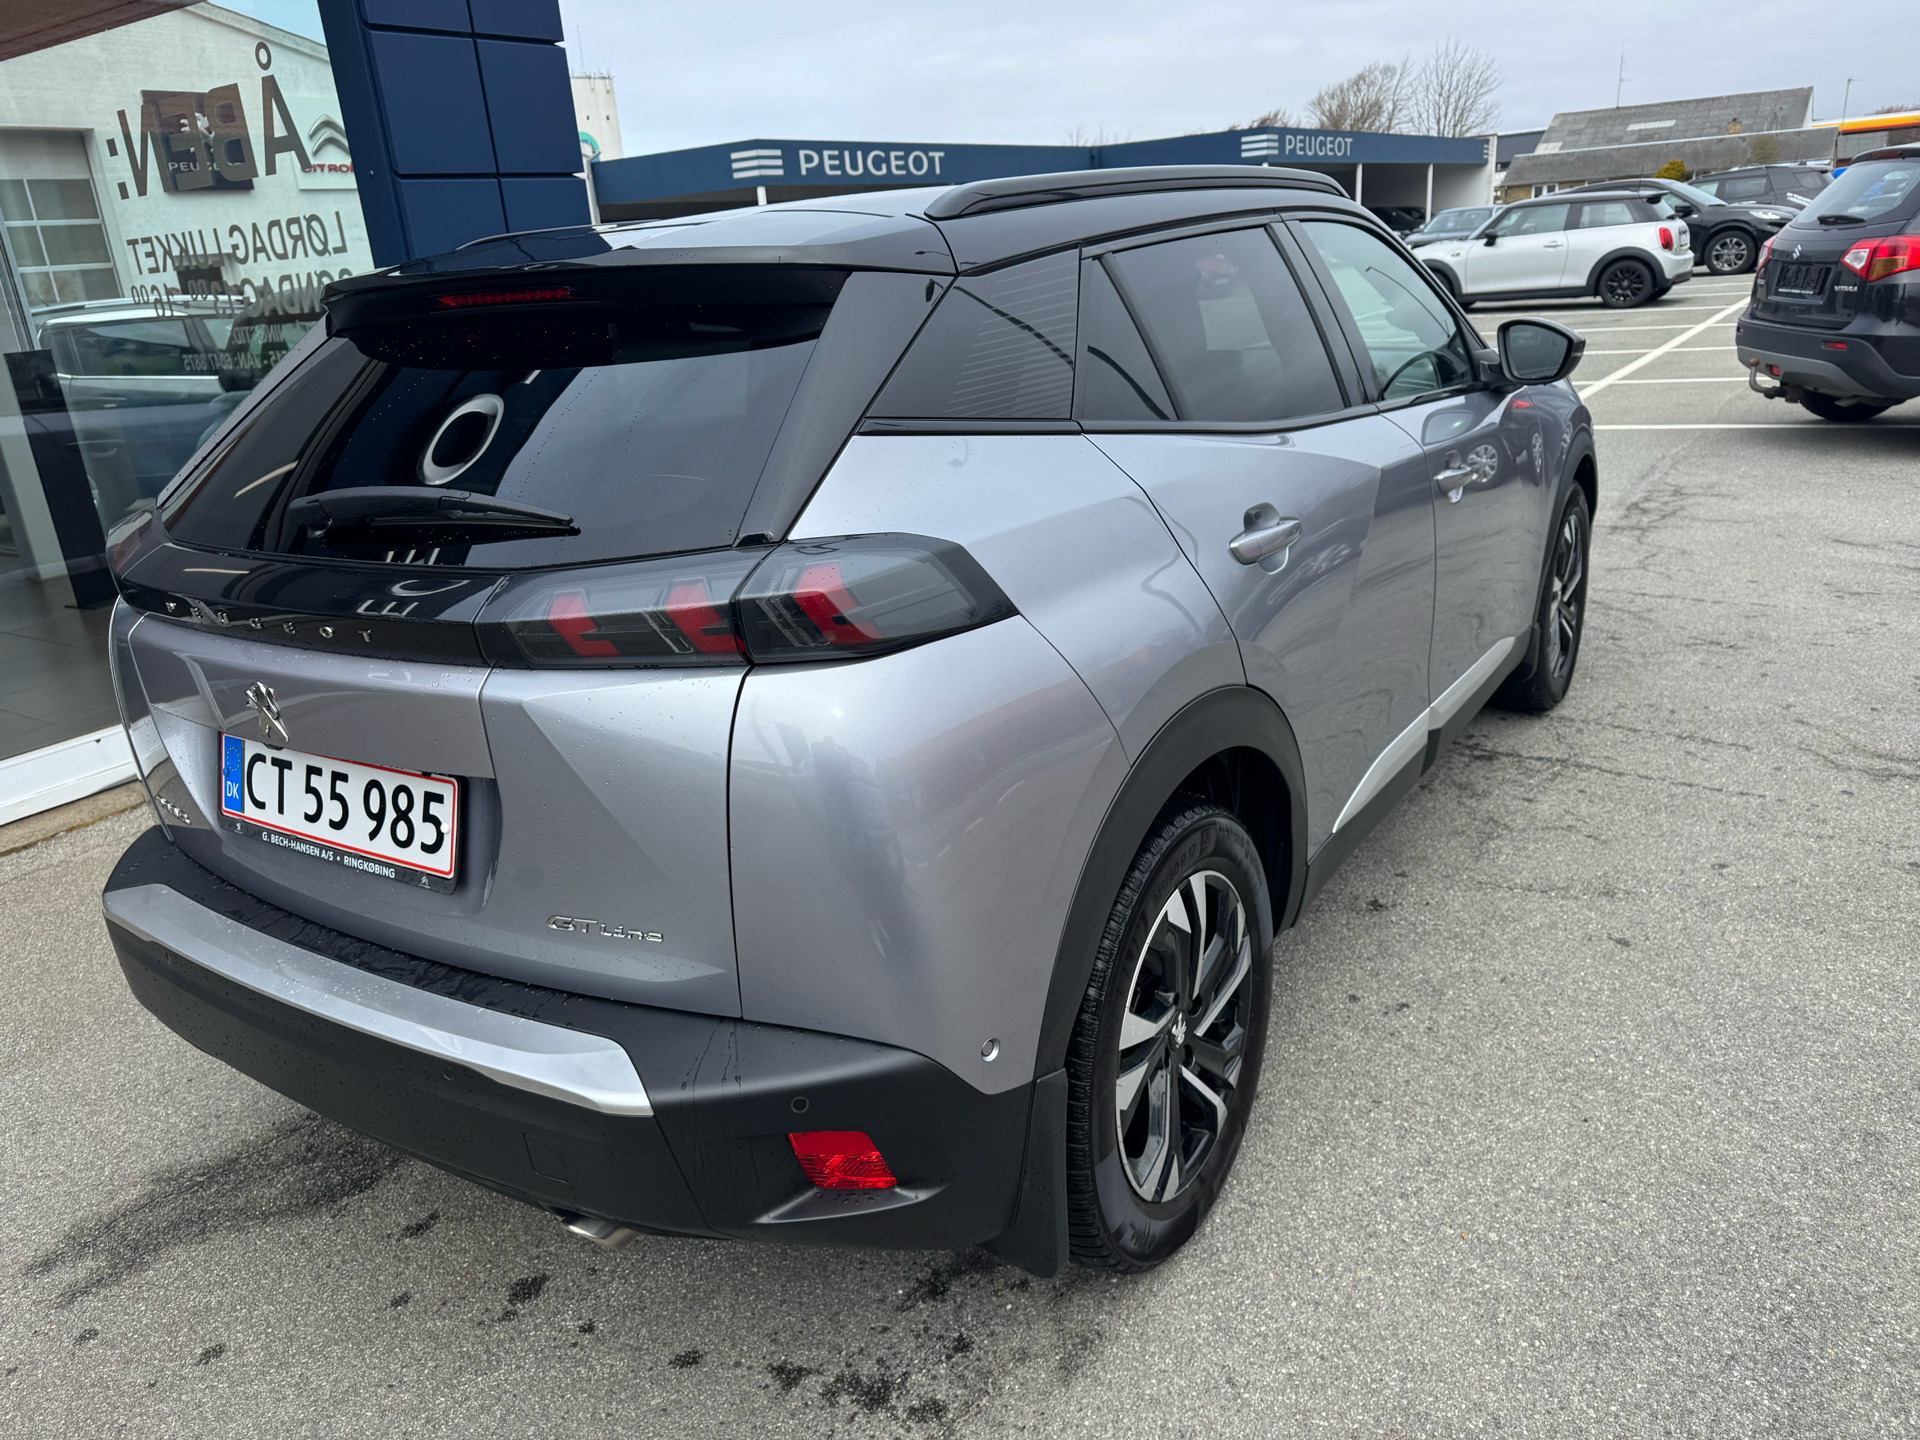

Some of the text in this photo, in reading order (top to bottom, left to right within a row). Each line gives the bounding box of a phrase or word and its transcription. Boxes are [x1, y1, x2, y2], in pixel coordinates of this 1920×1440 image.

[1285, 134, 1353, 156] PEUGEOT
[799, 150, 945, 176] PEUGEOT
[165, 601, 374, 642] PEUGEOT
[226, 780, 240, 799] DK
[246, 752, 293, 815] CT
[304, 764, 349, 831] 55
[363, 778, 445, 854] 985
[262, 831, 396, 878] G. BECH-HANSEN A/S RINGKØBING
[546, 914, 598, 933] GT
